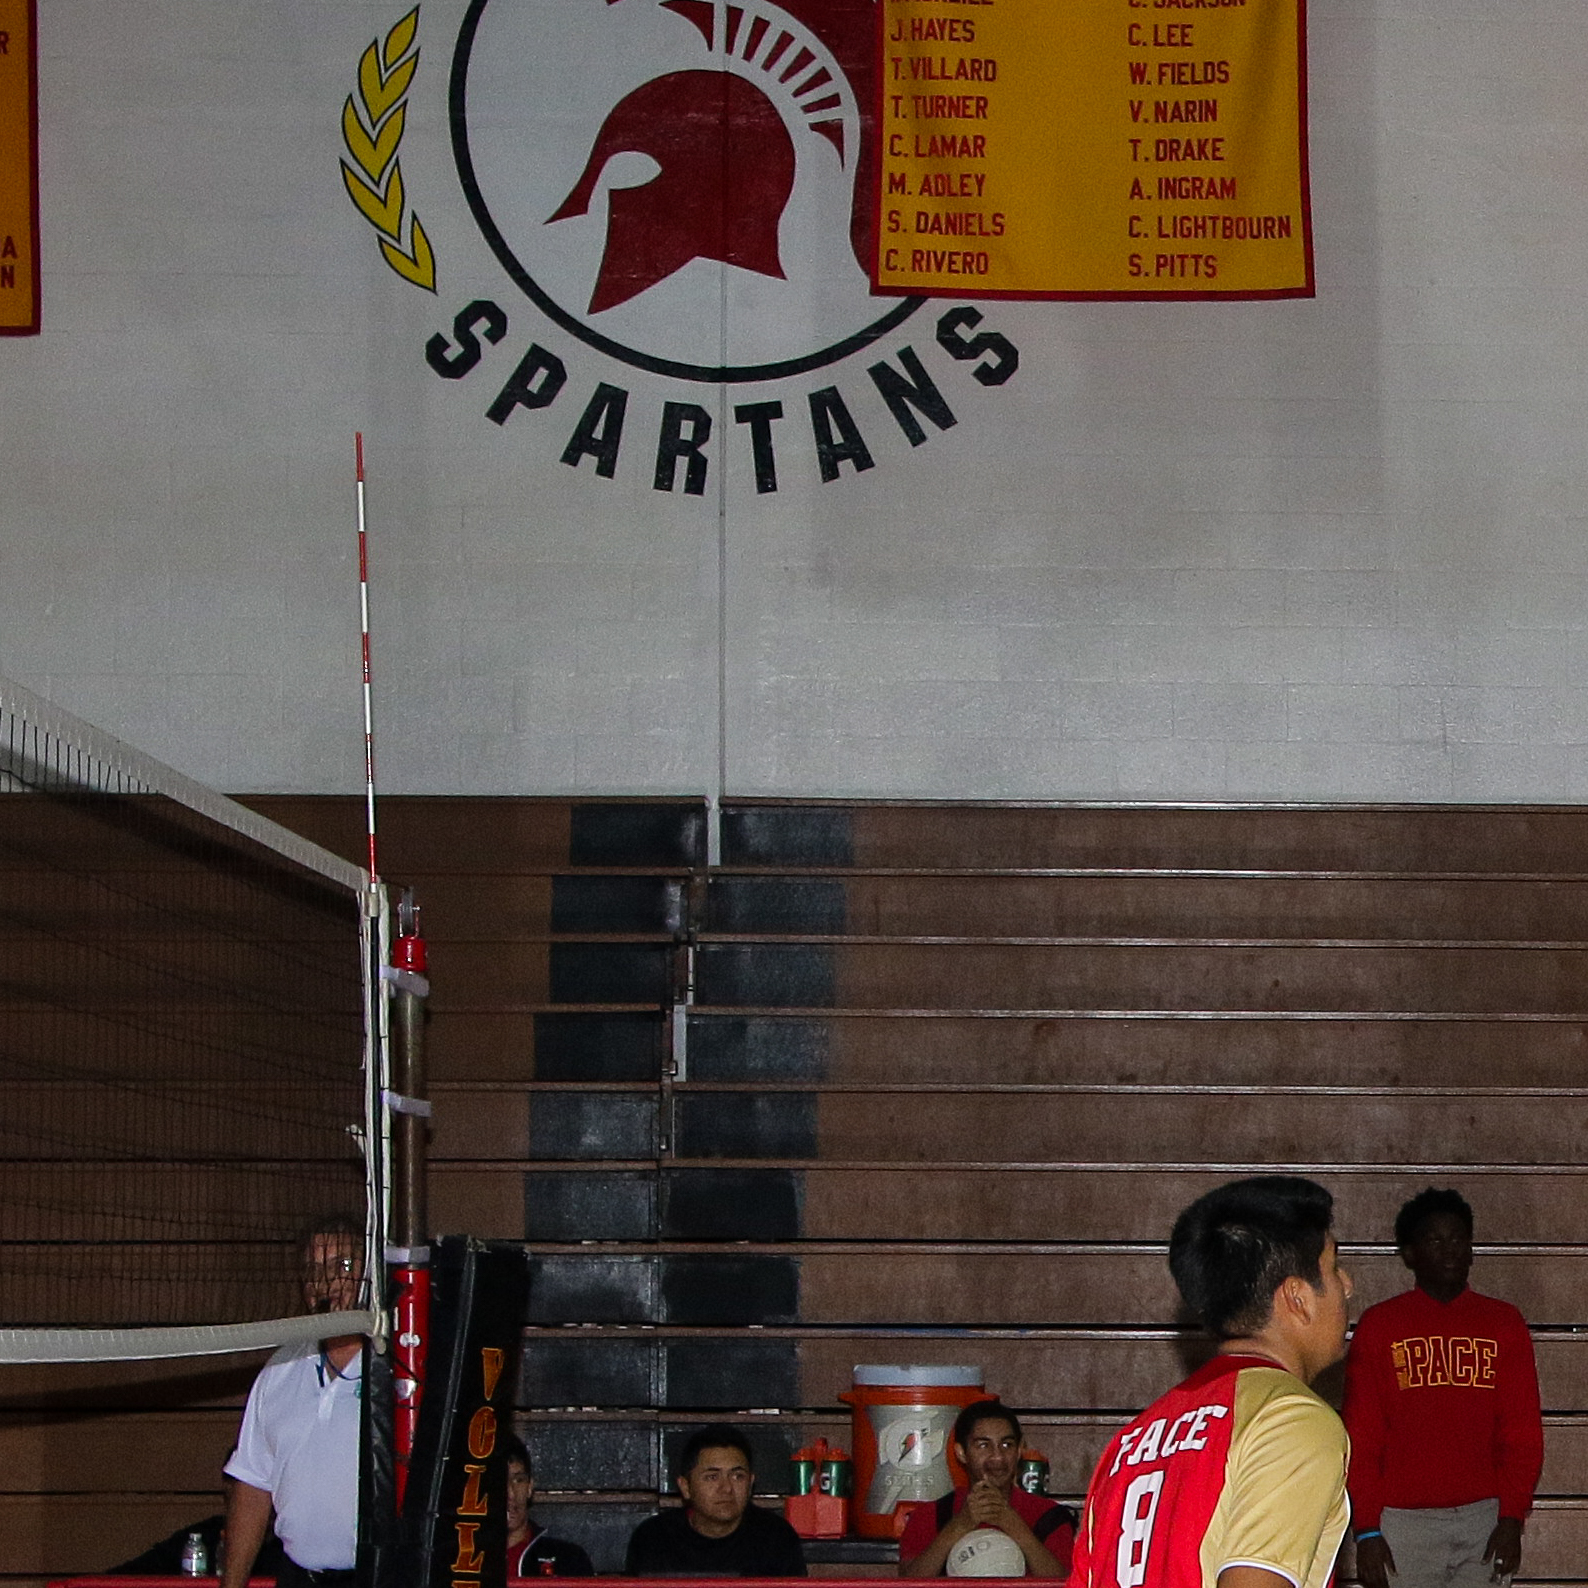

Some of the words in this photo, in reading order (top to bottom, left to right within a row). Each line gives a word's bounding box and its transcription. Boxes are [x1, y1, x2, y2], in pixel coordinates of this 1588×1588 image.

[891, 19, 907, 41] J.
[910, 18, 974, 42] HAYES
[1128, 23, 1147, 46] C.
[1153, 24, 1193, 47] LEE
[891, 57, 907, 80] T.
[909, 57, 996, 82] VILLARD
[1129, 63, 1151, 85] W.
[1158, 61, 1229, 85] FIELDS
[891, 95, 906, 118] T.
[912, 95, 988, 119] TURNER
[1130, 100, 1148, 123] V.
[1155, 99, 1217, 123] NARIN
[890, 134, 908, 157] C.
[915, 135, 985, 158] LAMAR
[1129, 139, 1149, 162] T.
[1155, 138, 1224, 161] DRAKE
[889, 173, 911, 195] M.
[919, 173, 985, 197] ADLEY
[1130, 178, 1151, 200] A.
[1158, 177, 1236, 199] INGRAM
[888, 210, 907, 233] S.
[916, 211, 1004, 236] DANIELS
[1129, 216, 1148, 238] C.
[1158, 216, 1291, 239] LIGHTBOURN
[885, 249, 904, 271] C.
[912, 250, 989, 274] RIVERO
[1129, 254, 1149, 276] S.
[1156, 254, 1216, 278] PITTS
[426, 300, 1018, 496] SPARTANS
[1403, 1336, 1497, 1388] PACE
[1117, 1470, 1164, 1588] 8
